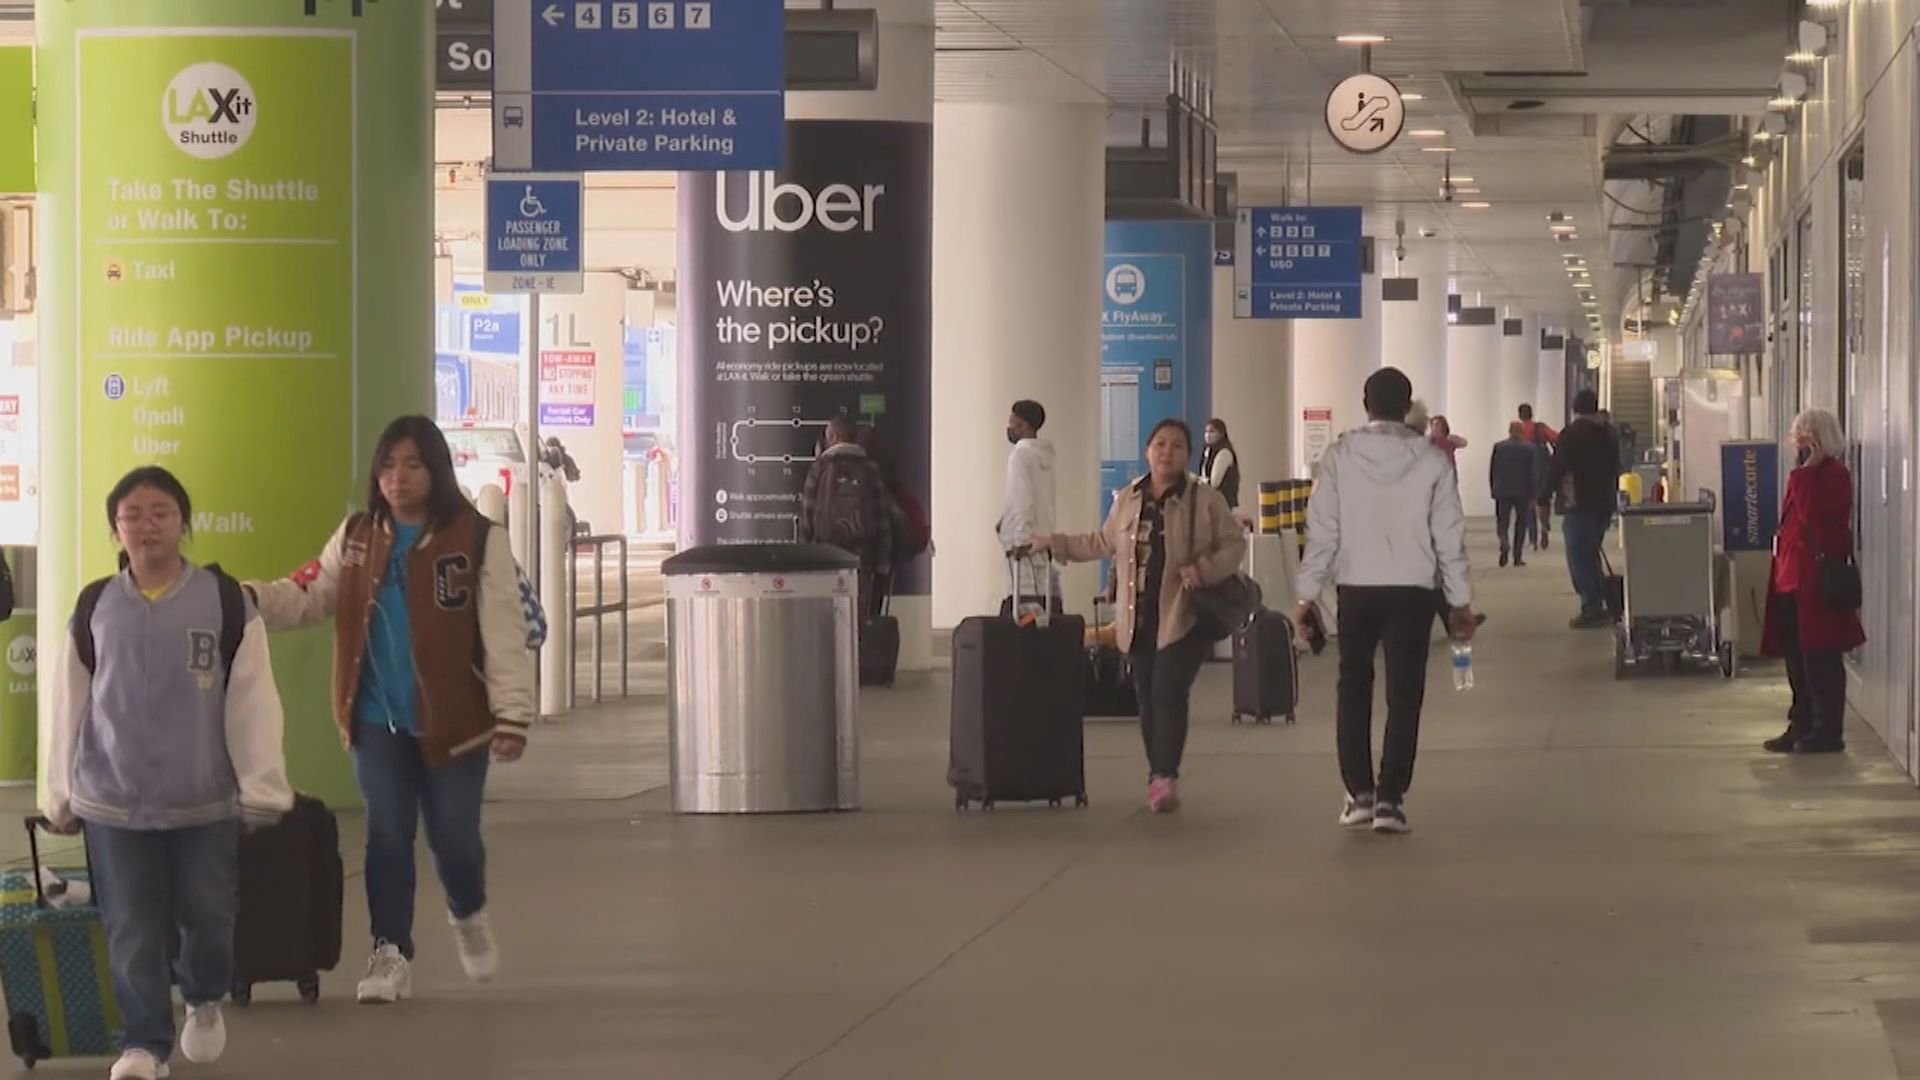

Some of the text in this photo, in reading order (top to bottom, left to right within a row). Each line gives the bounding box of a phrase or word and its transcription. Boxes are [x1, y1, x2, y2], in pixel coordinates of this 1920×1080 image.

[582, 7, 704, 24] 4 5 6 7
[576, 109, 737, 126] Level 2: Hotel &
[180, 131, 238, 144] Shuttle
[576, 136, 734, 156] Private Parking
[108, 179, 319, 200] Take The Shuttle
[715, 169, 885, 232] Uber
[108, 209, 247, 230] or Walk To:
[505, 220, 561, 235] PASSENGER
[498, 237, 569, 251] LOADING ZONE
[520, 254, 546, 267] ONLY
[133, 261, 176, 280] Taxi
[512, 277, 536, 289] ZONE
[716, 280, 834, 307] Where’s
[1270, 292, 1295, 300] Level
[1270, 303, 1341, 313] Private Parking
[473, 319, 500, 332] P2a
[1113, 311, 1167, 325] FlyAway
[108, 327, 312, 352] Ride App Pickup
[716, 316, 884, 350] the pickup?
[543, 353, 594, 364] TOW-AWAY
[133, 376, 170, 397] Lyft
[133, 408, 184, 428] Opoli
[133, 436, 181, 455] Uber
[191, 511, 254, 533] Walk
[434, 553, 472, 611] C
[187, 628, 217, 671] B
